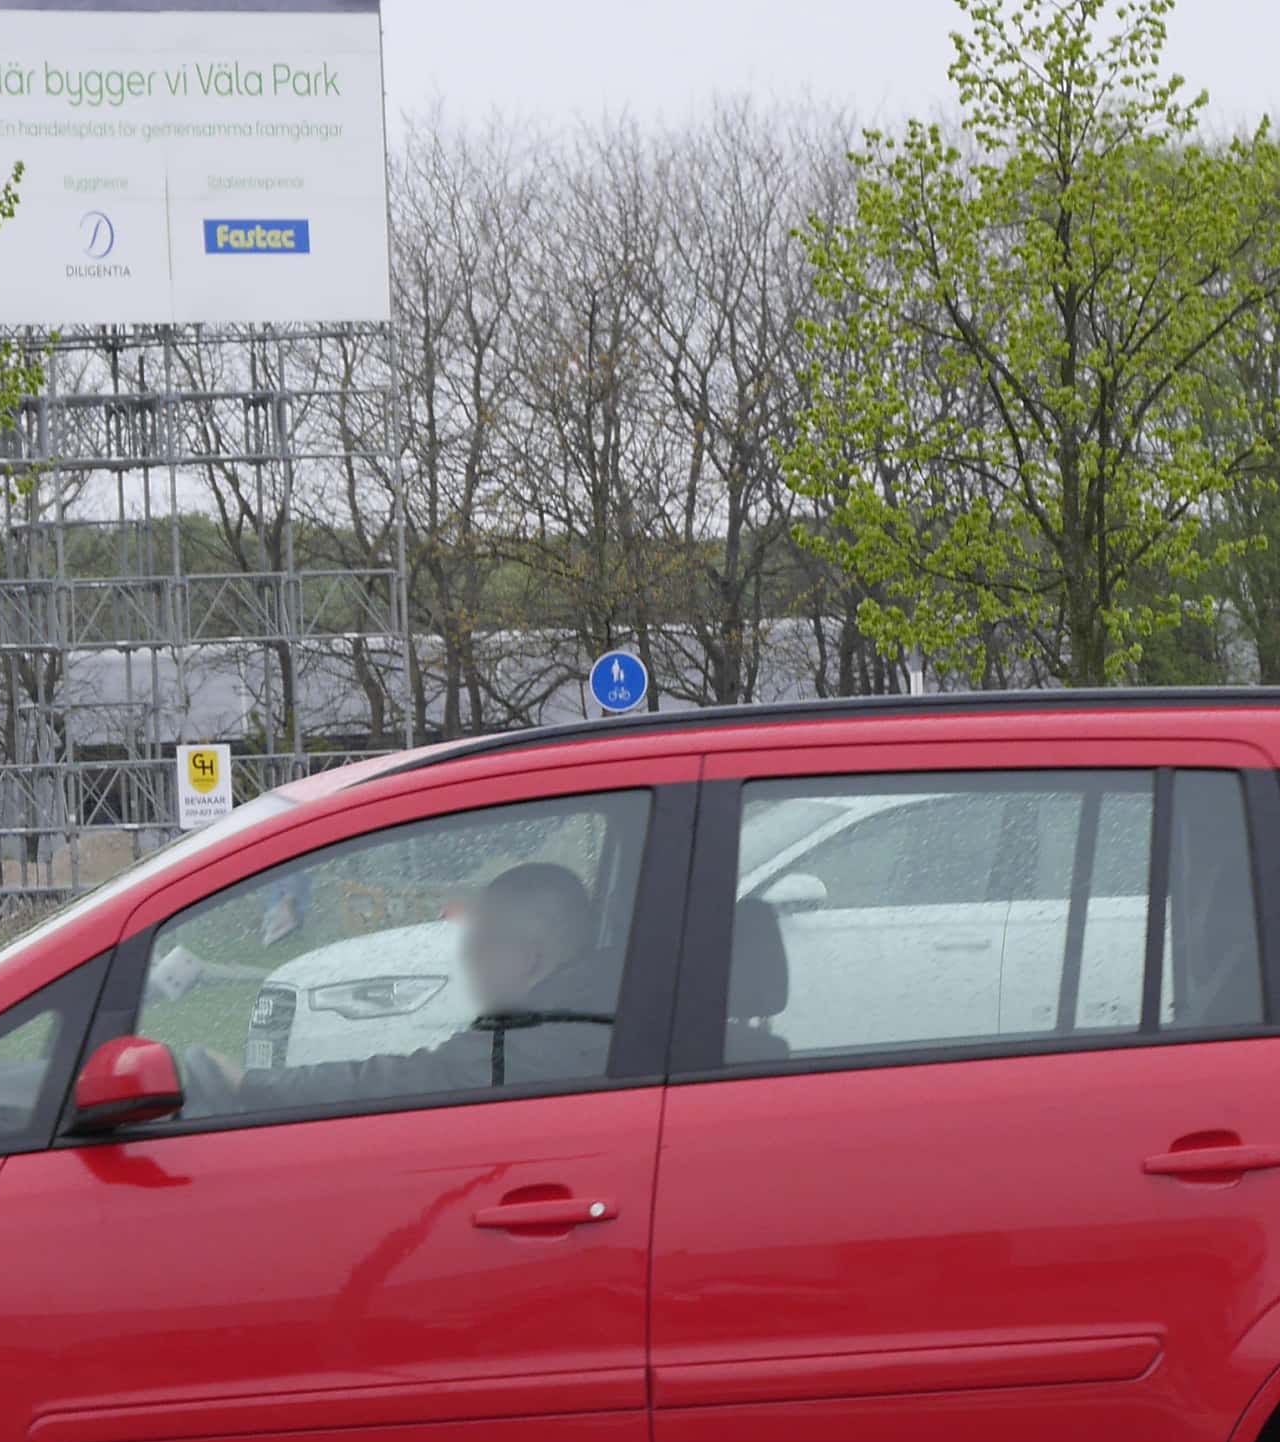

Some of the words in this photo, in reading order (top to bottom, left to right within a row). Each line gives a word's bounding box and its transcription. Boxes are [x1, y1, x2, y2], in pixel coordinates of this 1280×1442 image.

[45, 60, 156, 107] bygger
[165, 63, 188, 96] vi
[195, 61, 263, 96] Väla
[272, 61, 341, 96] Park
[19, 119, 115, 140] handelsplats
[141, 122, 253, 143] gemensamma
[65, 264, 131, 278] DILIGENTIA
